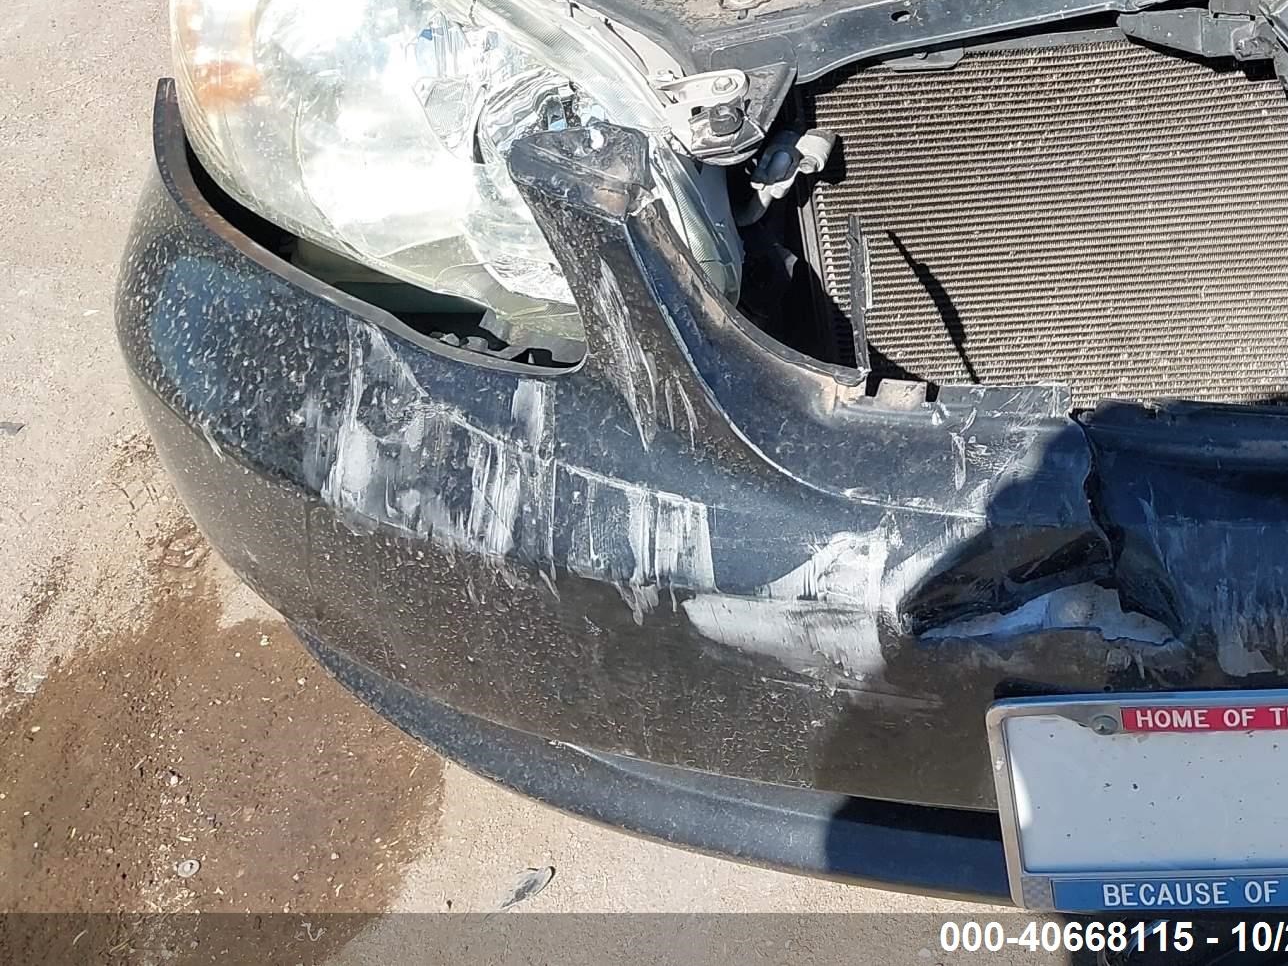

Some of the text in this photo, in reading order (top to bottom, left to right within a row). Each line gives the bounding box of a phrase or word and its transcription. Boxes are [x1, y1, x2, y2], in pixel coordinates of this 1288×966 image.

[1136, 709, 1210, 728] HOME
[1223, 709, 1256, 727] OF
[1103, 882, 1230, 907] BECAUSE
[1244, 881, 1280, 904] OF
